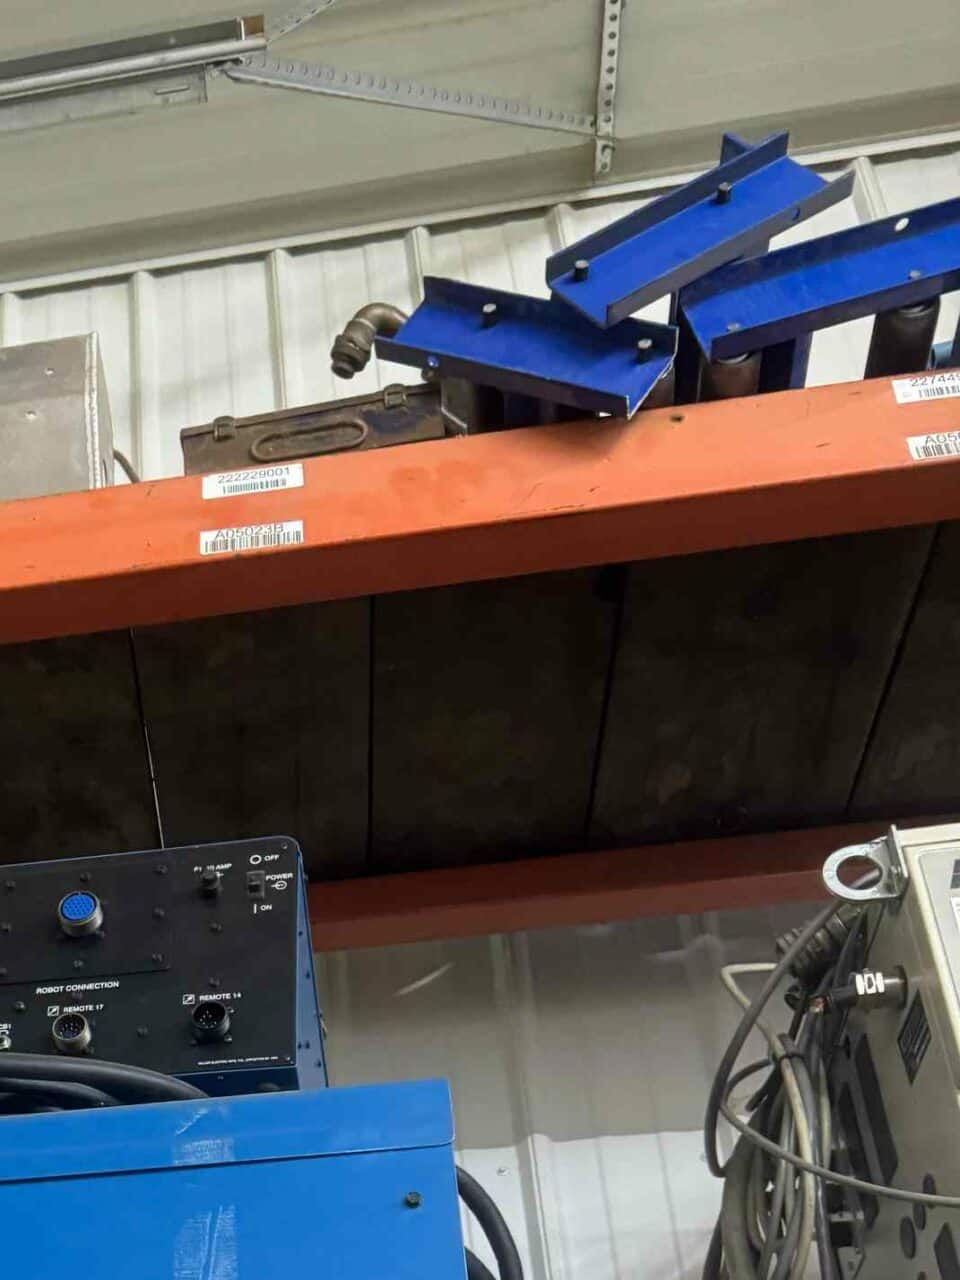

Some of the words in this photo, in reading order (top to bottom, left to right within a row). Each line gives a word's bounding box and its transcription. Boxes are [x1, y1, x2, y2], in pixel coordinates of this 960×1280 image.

[925, 432, 960, 445] A05
[264, 854, 280, 862] OFF
[215, 862, 233, 870] AMP
[265, 872, 293, 881] POWER
[36, 985, 64, 994] ROBOT
[65, 981, 120, 993] CONNECTION
[199, 993, 230, 1001] REMOTE
[63, 1004, 94, 1012] REMOTE
